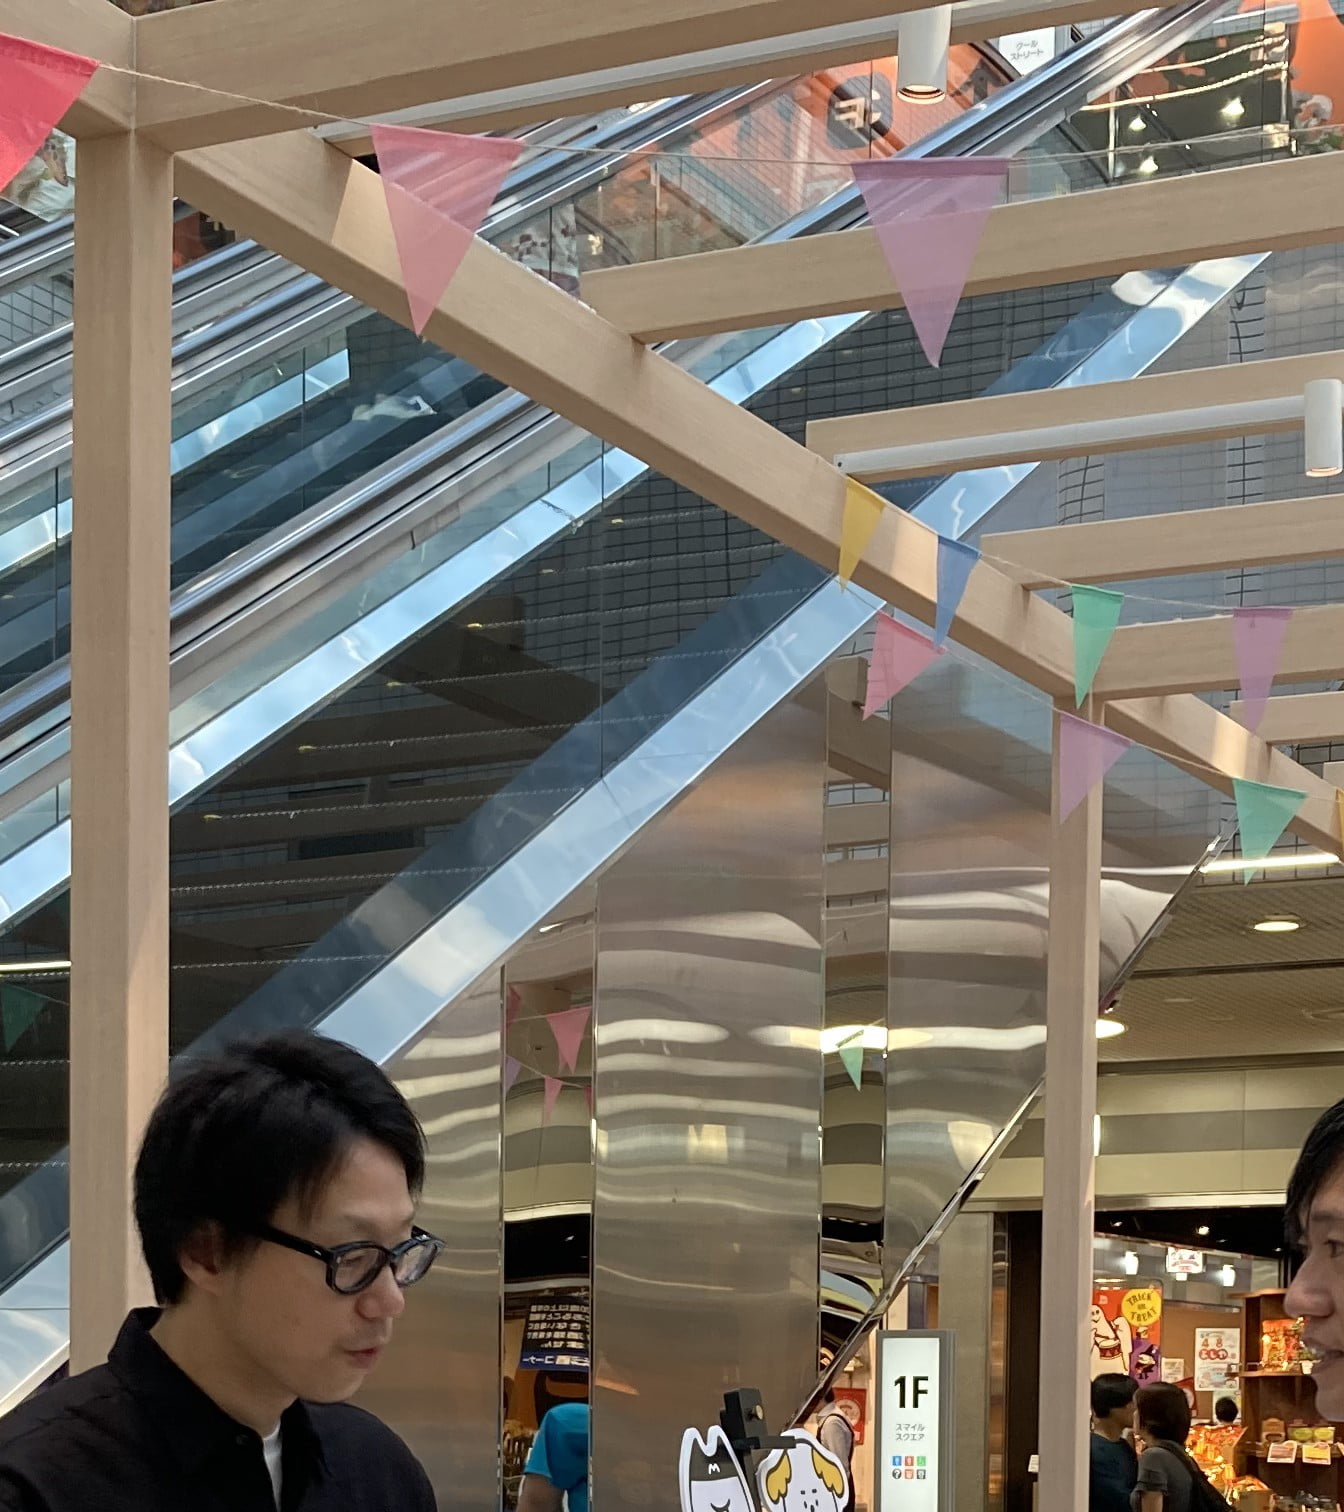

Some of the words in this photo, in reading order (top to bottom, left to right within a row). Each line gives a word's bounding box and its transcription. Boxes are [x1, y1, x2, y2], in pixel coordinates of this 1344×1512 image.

[1016, 40, 1038, 51] クール
[1010, 48, 1044, 60] ストリート
[1126, 1290, 1154, 1306] TRICK
[1131, 1306, 1157, 1322] TREAT
[894, 1375, 929, 1409] 1F
[896, 1423, 926, 1432] スマイル
[895, 1433, 925, 1442] スクエア
